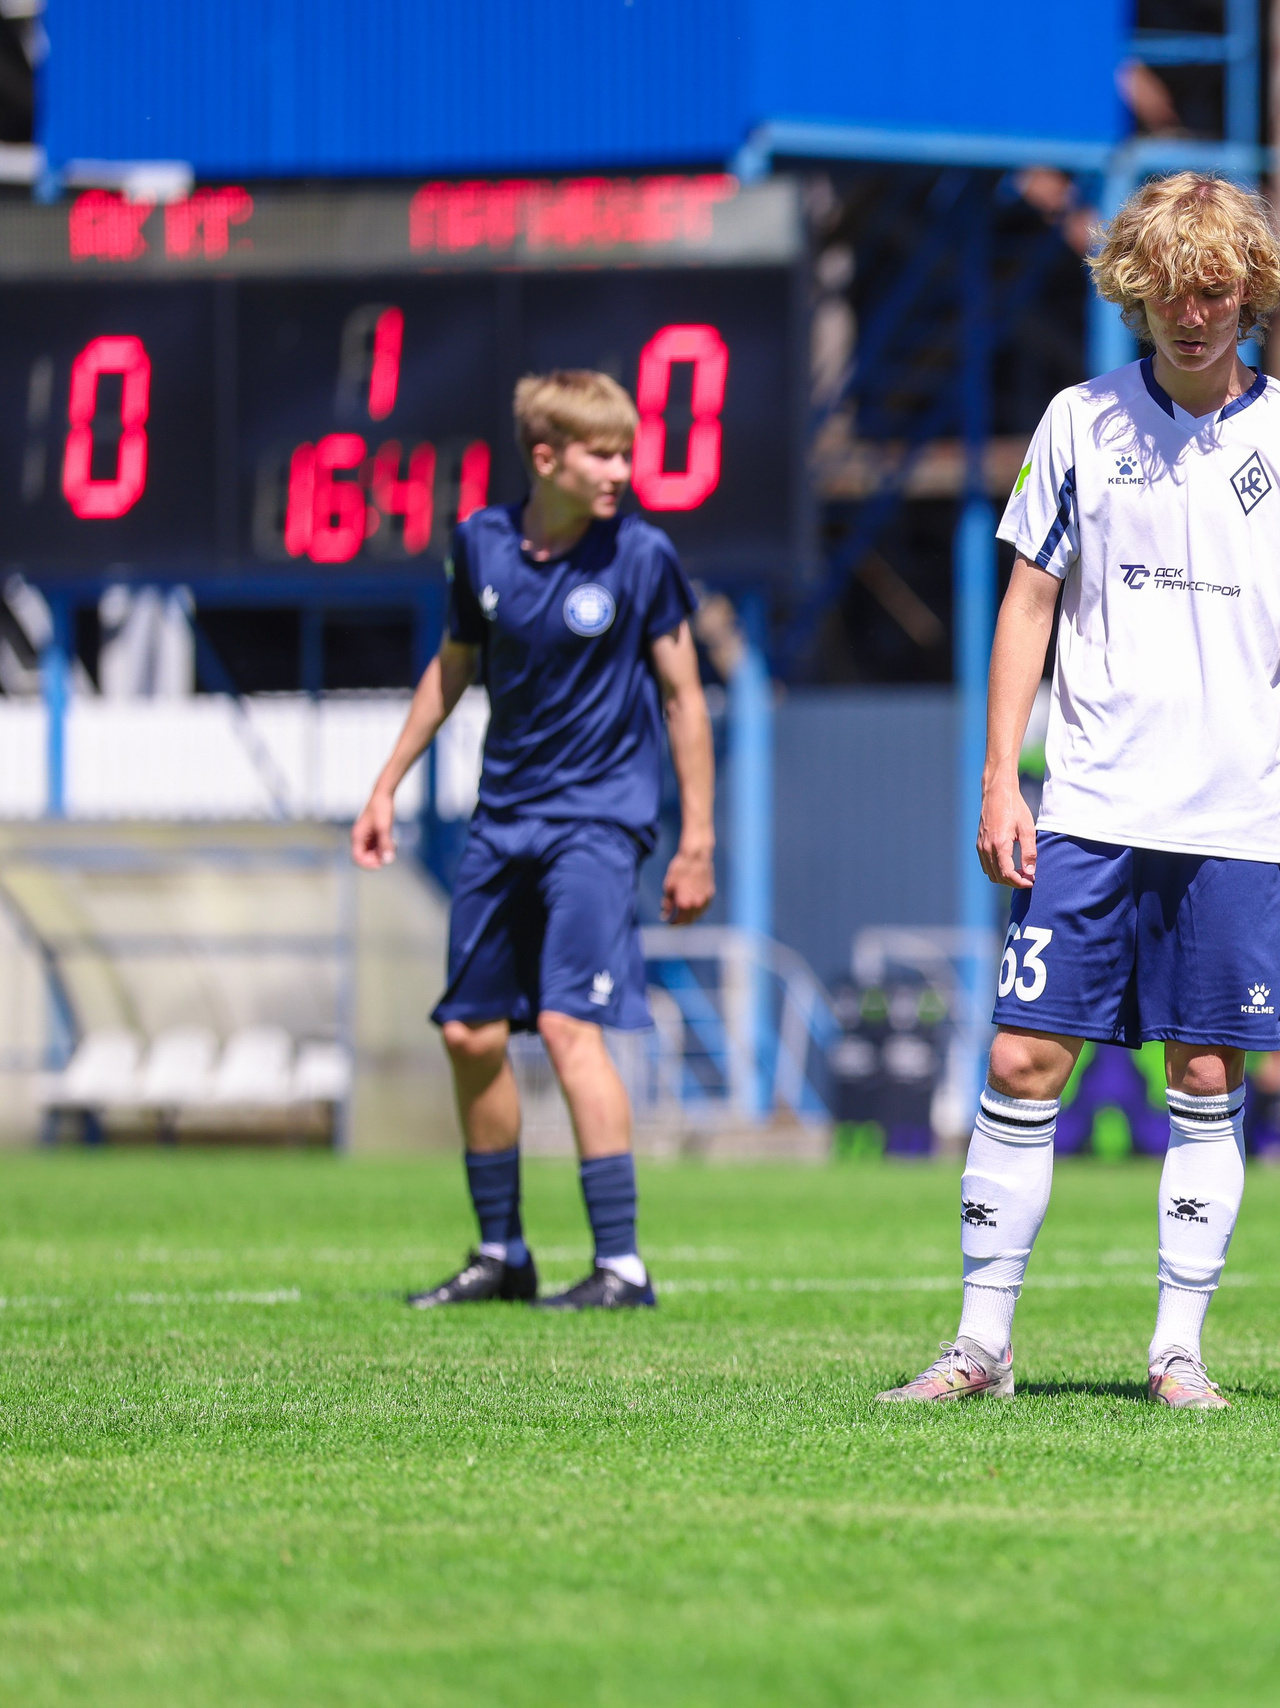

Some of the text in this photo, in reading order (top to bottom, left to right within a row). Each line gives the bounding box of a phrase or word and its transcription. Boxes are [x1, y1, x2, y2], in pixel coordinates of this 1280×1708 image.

[368, 305, 405, 422] 1
[62, 335, 151, 519] 0
[632, 324, 729, 511] 0
[1107, 477, 1144, 485] KELME
[1154, 567, 1184, 578] ДСК
[998, 921, 1054, 1002] 63
[1240, 1004, 1275, 1014] KELME
[1166, 1209, 1209, 1224] KELME
